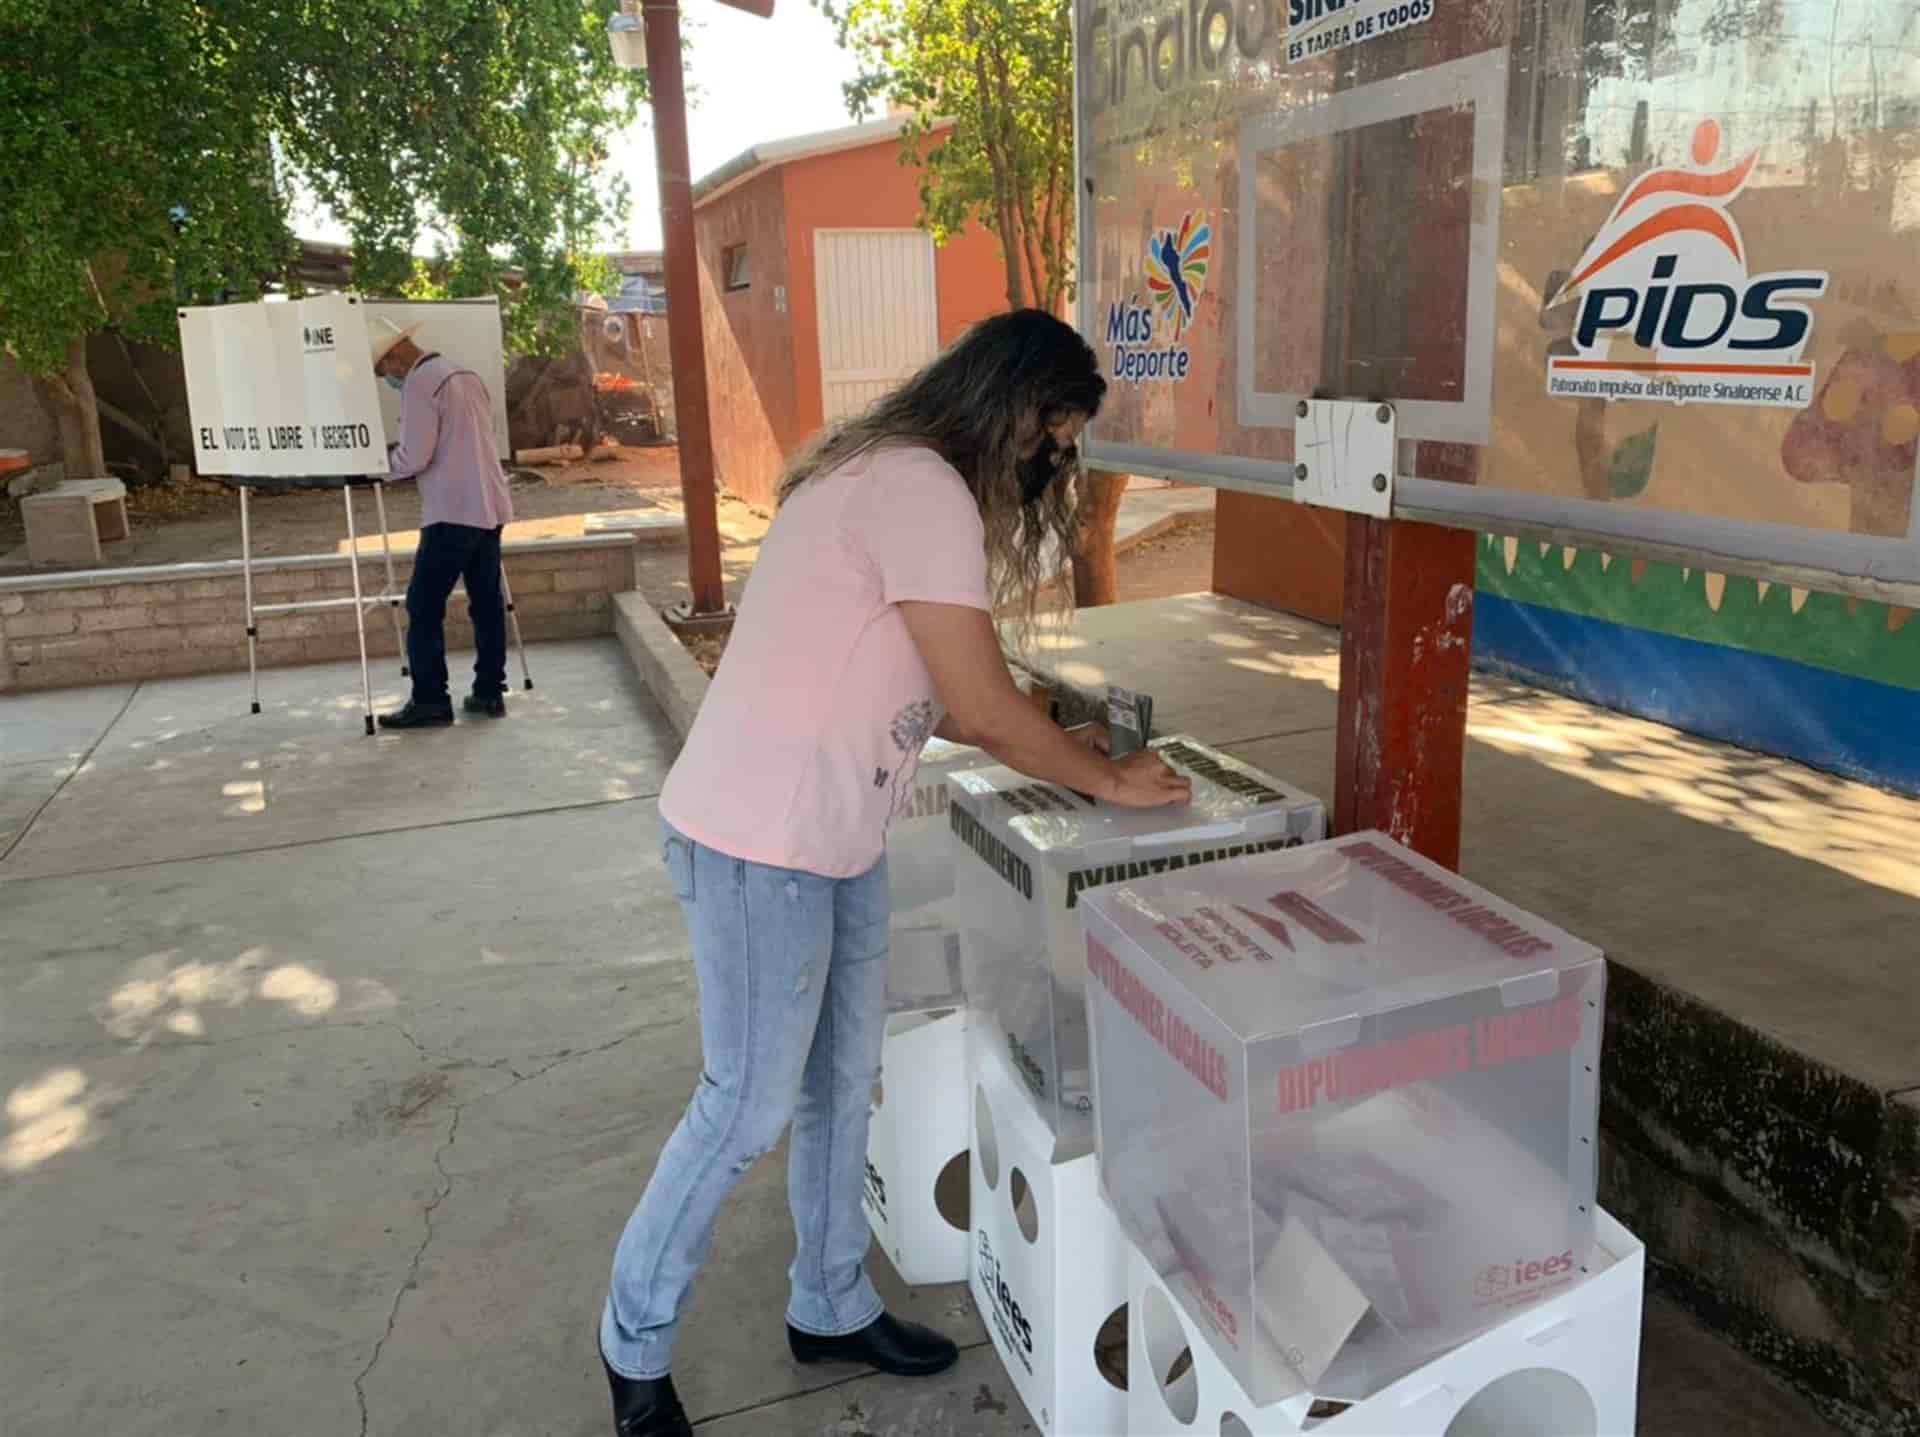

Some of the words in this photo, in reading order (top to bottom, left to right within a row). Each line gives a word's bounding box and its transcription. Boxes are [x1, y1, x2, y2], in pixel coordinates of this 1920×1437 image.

[1289, 43, 1303, 60] ES
[1307, 25, 1350, 54] TAREA
[1355, 16, 1375, 38] DE
[1378, 0, 1430, 30] TODOS
[1107, 294, 1152, 342] Más
[1114, 345, 1189, 384] Deporte
[1646, 378, 1664, 396] del
[1666, 380, 1711, 400] Deporte
[1713, 382, 1783, 401] Sinaloense
[200, 427, 220, 449] EL
[248, 427, 261, 450] ES
[267, 425, 304, 450] LIBRE
[321, 423, 371, 449] SECRETO
